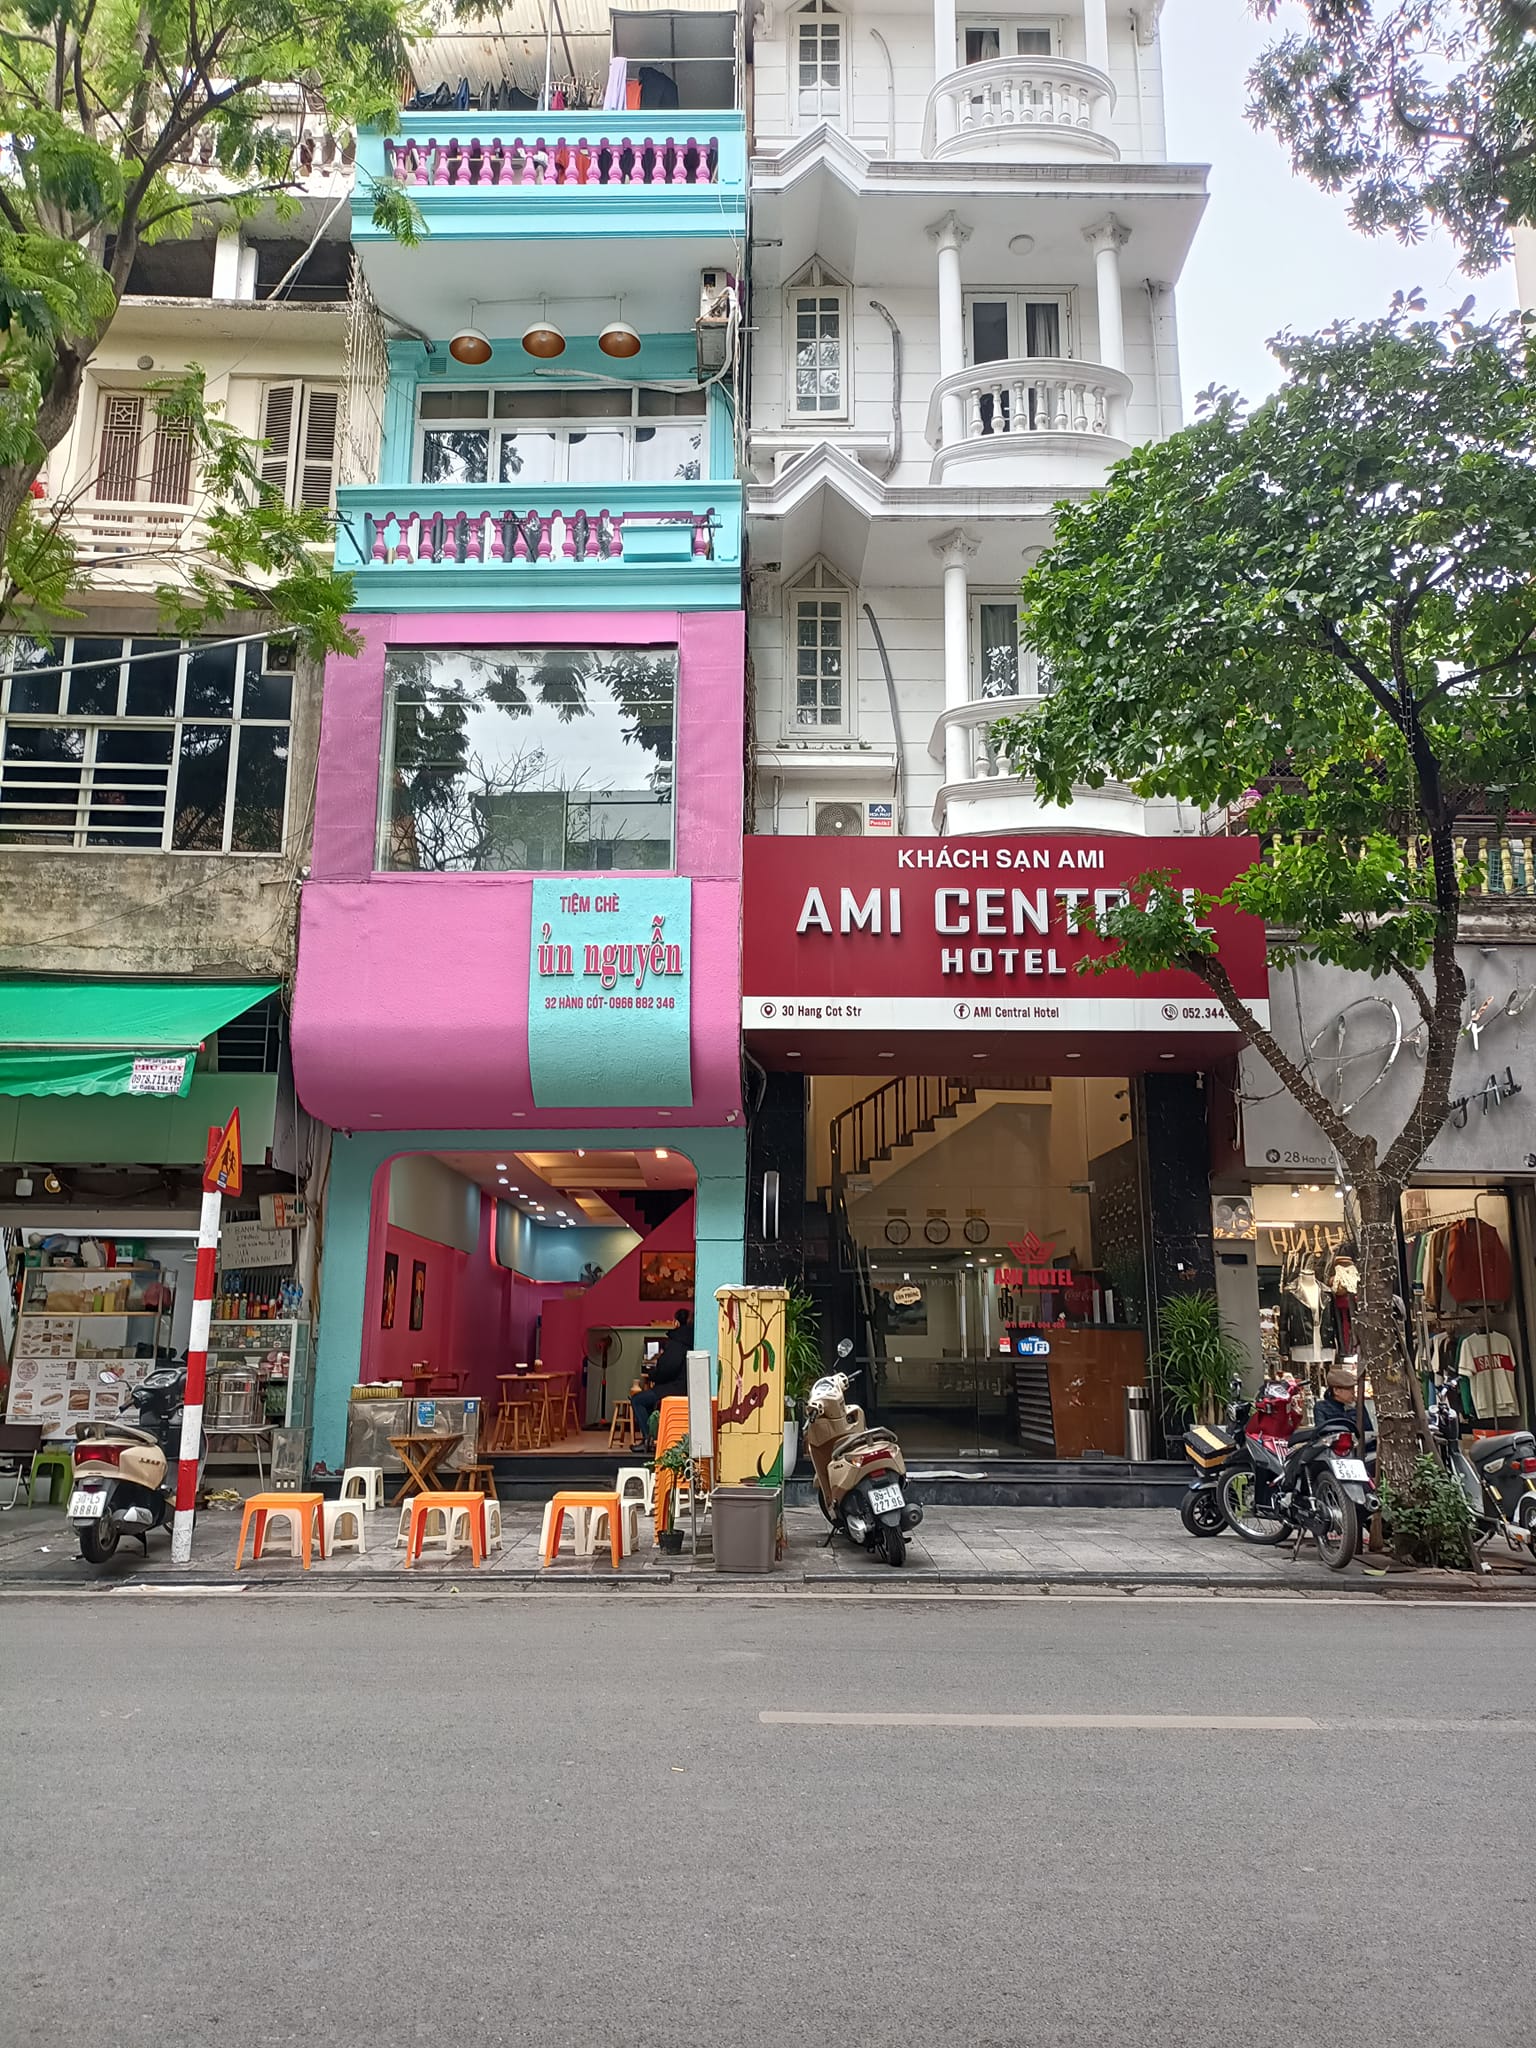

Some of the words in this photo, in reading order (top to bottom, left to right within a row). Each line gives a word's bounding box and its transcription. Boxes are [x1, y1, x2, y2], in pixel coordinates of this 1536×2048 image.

[898, 845, 989, 869] KHÁCH
[996, 849, 1050, 873] SẠN
[1058, 849, 1105, 869] AMI
[560, 892, 590, 915] TIỆM
[595, 892, 619, 913] CHÈ
[796, 887, 901, 936] AMI
[583, 915, 683, 989] nguyễn
[941, 948, 1067, 976] HOTEL
[545, 997, 556, 1008] 32
[559, 995, 583, 1009] HÀNG
[609, 997, 632, 1009] 0966
[635, 997, 654, 1009] 882
[782, 1005, 794, 1016] 30
[798, 1005, 822, 1018] Hang
[825, 1005, 842, 1017] Cot
[846, 1005, 862, 1017] Str
[973, 1006, 992, 1018] AMI
[995, 1006, 1031, 1018] Central
[1034, 1006, 1060, 1018] Hotel
[1284, 1151, 1300, 1163] 28
[1302, 1155, 1327, 1165] Hang
[994, 1268, 1023, 1285] AMI
[1028, 1268, 1074, 1286] HOTEL
[1020, 1343, 1033, 1352] Wi
[1037, 1343, 1048, 1352] Fi
